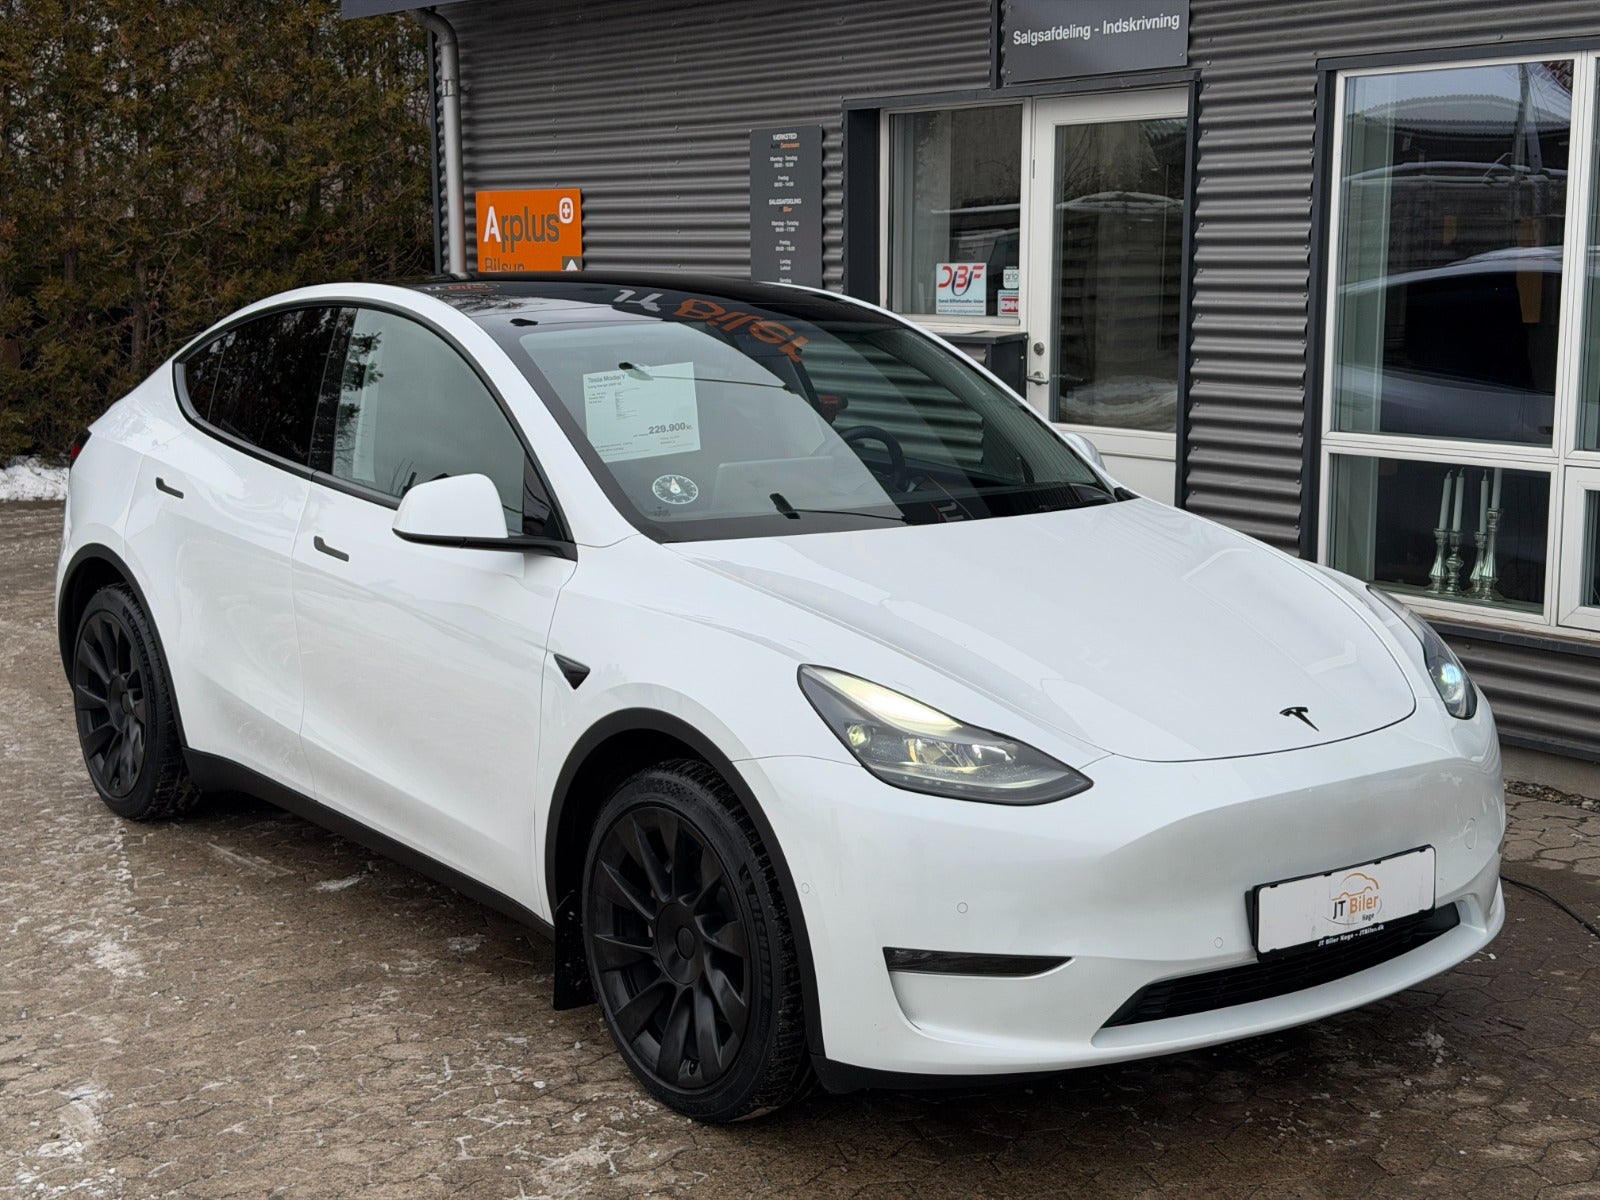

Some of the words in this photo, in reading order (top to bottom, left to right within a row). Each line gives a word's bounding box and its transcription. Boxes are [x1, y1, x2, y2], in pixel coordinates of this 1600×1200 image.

[1013, 24, 1091, 46] Salgsafdeling
[1103, 13, 1180, 35] Indskrivning
[1333, 900, 1346, 920] JT
[1349, 895, 1378, 914] Biler
